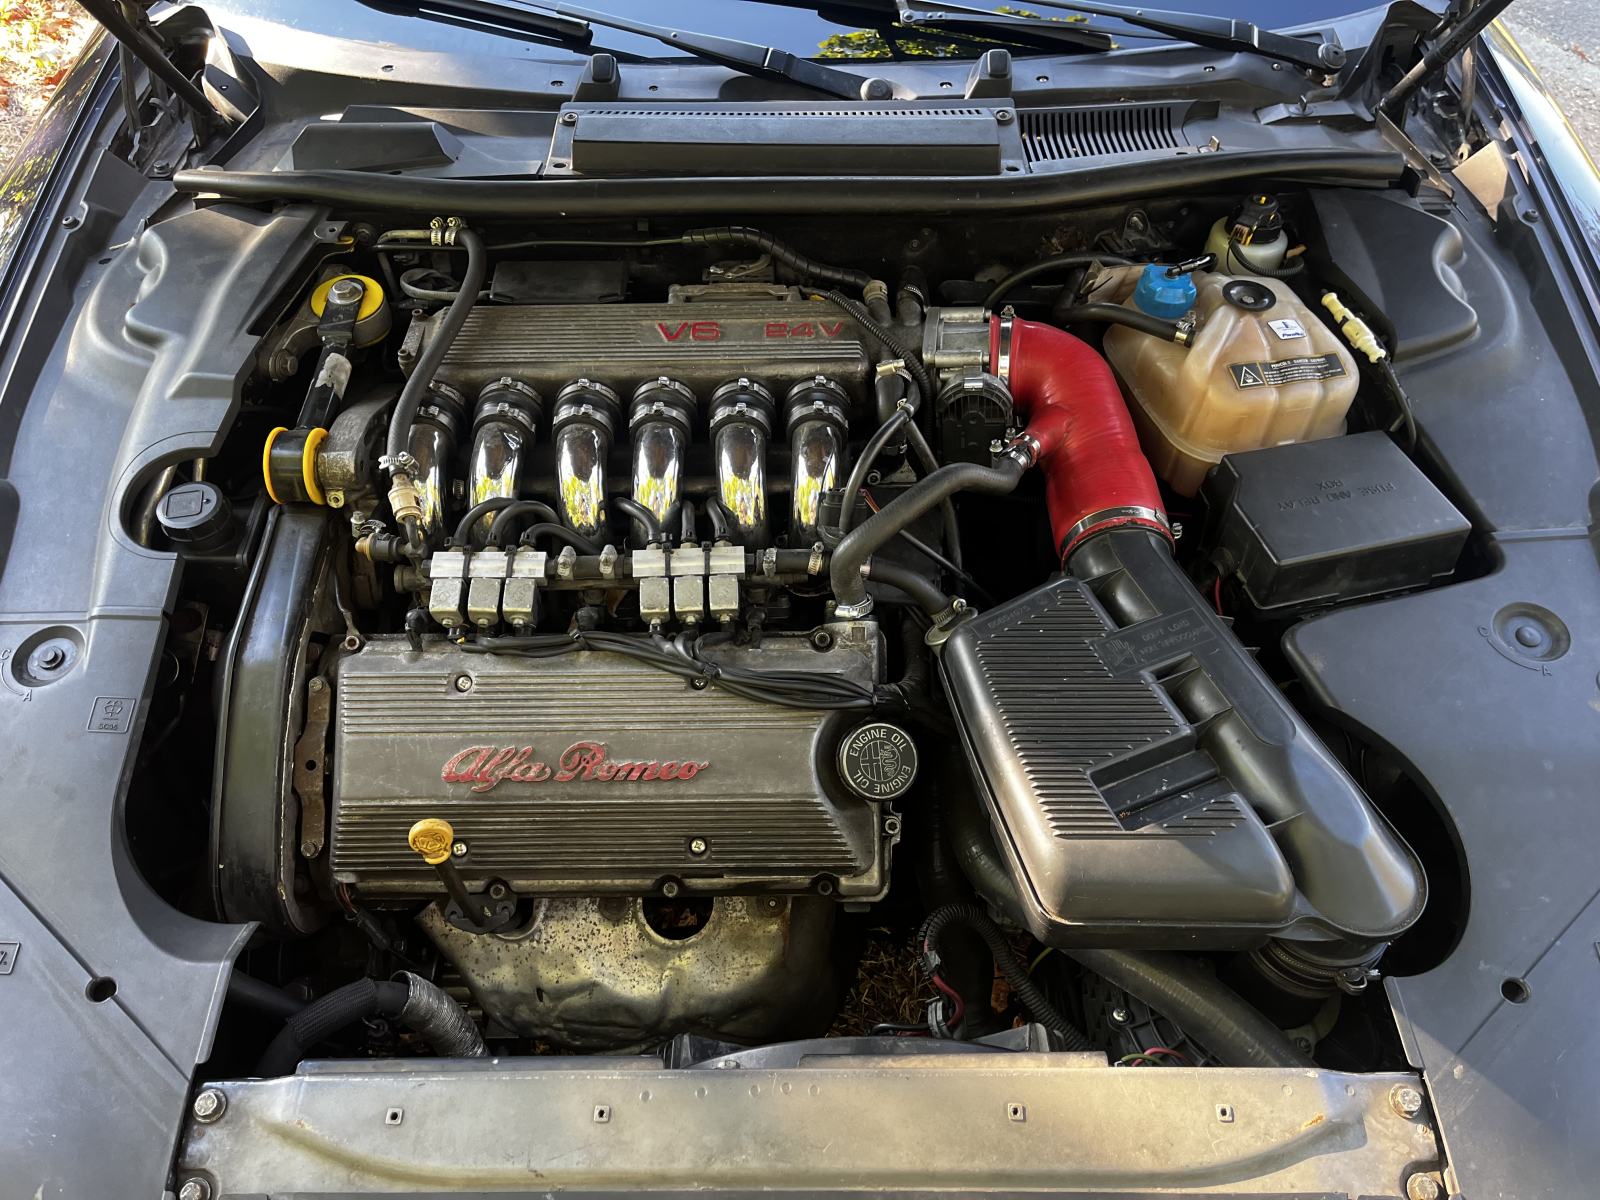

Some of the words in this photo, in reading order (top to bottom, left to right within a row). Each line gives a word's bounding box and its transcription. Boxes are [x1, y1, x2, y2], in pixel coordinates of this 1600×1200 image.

[656, 321, 721, 342] V6
[763, 320, 845, 338] 24V
[1315, 479, 1344, 491] BOX
[1277, 495, 1320, 511] RELAY
[1326, 490, 1351, 502] AND
[22, 689, 33, 702] A
[849, 728, 887, 757] ENGINE
[890, 733, 907, 752] OIL
[441, 744, 552, 793] Alfa
[553, 740, 711, 782] Romeo
[853, 769, 869, 789] OIL
[873, 765, 911, 793] ENGINE
